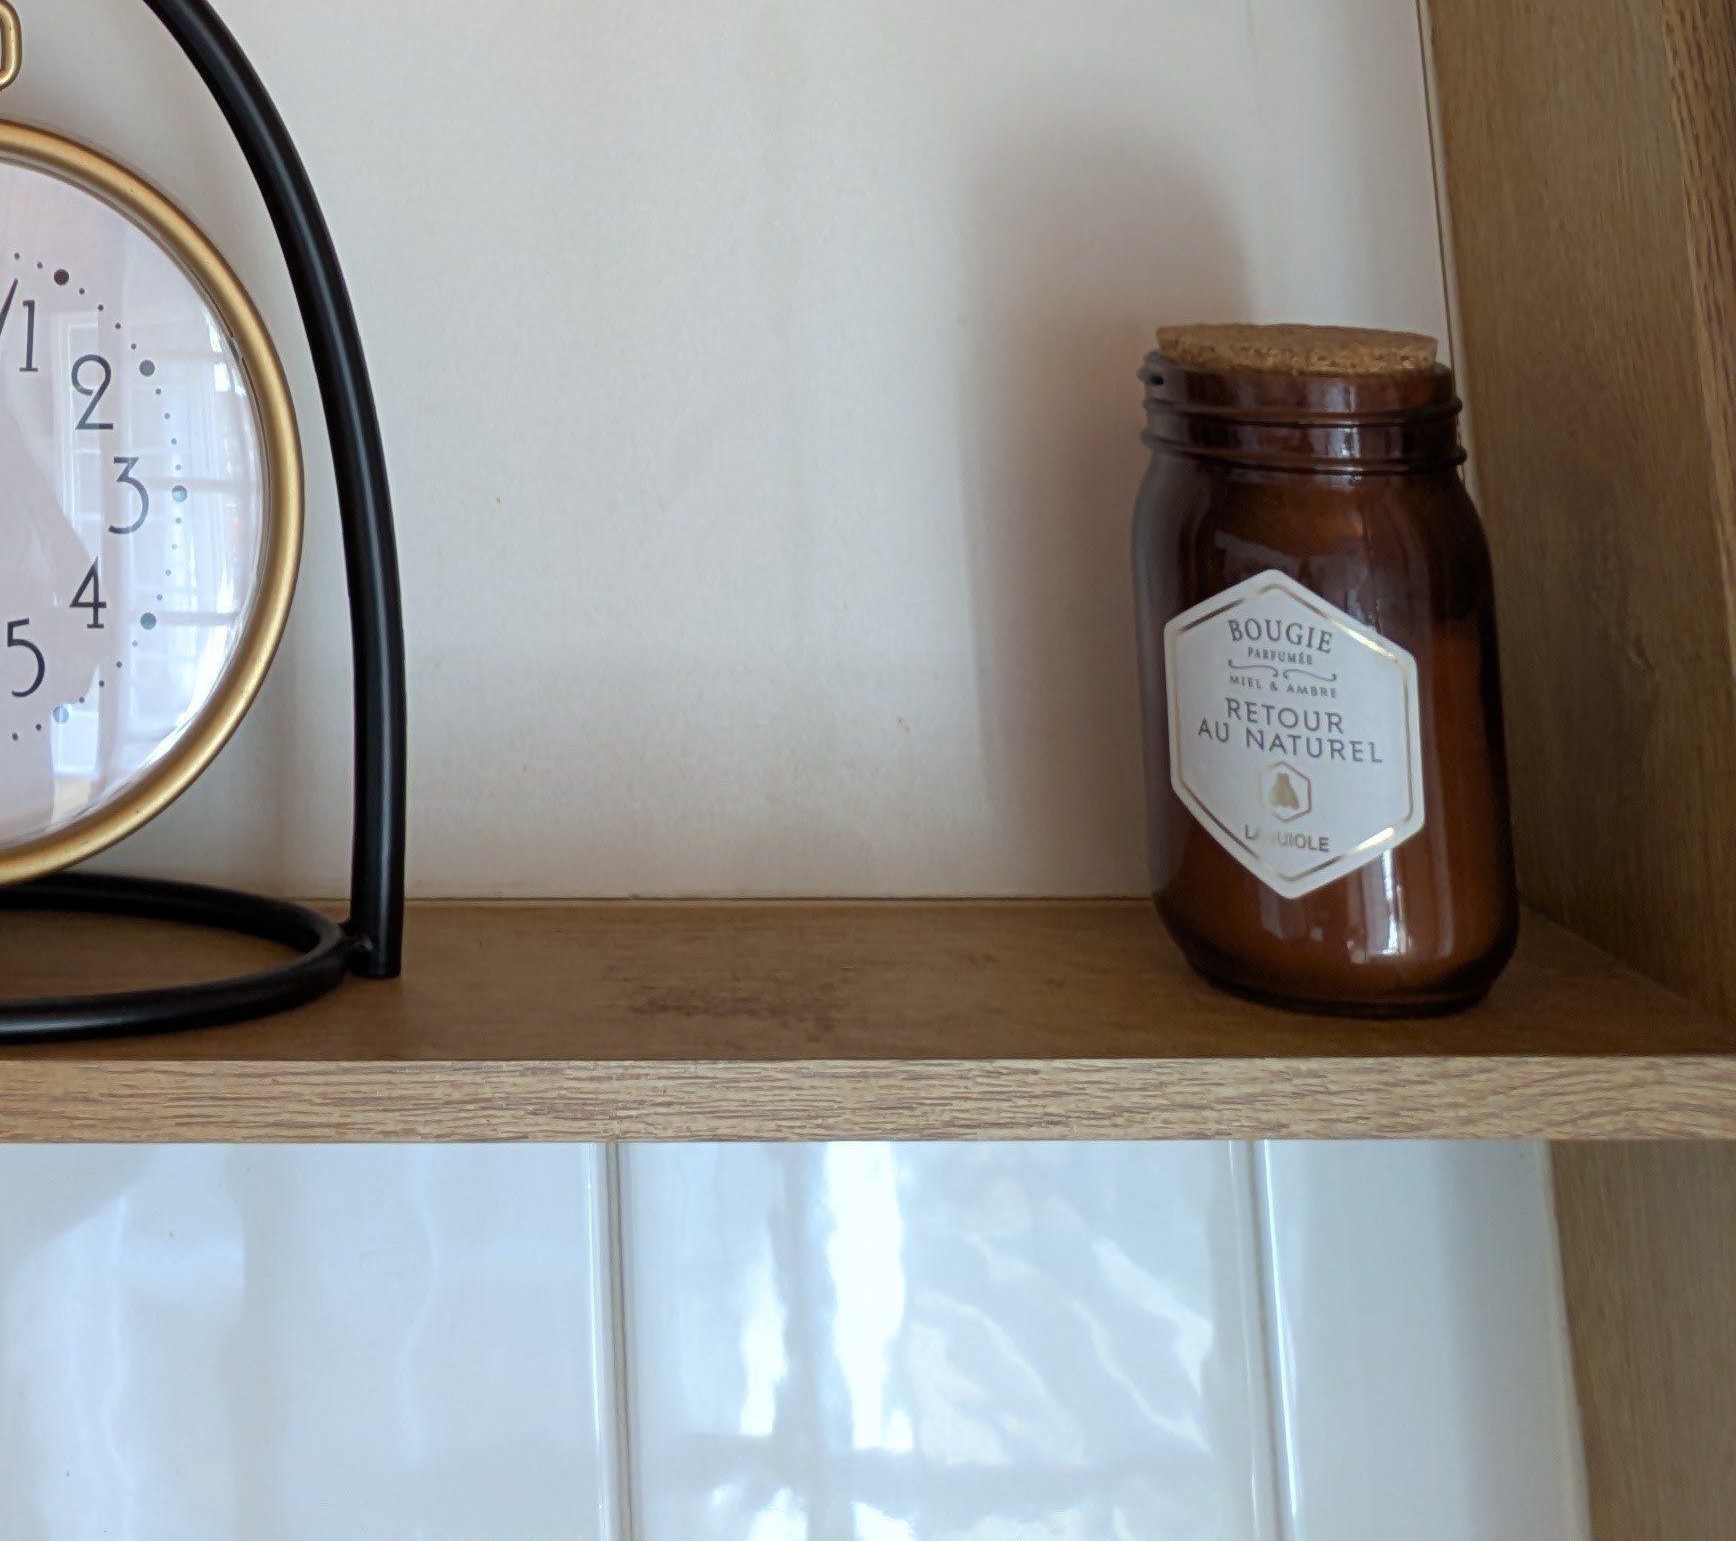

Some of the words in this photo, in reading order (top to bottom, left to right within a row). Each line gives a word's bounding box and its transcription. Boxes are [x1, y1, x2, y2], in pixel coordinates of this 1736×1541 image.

[19, 299, 39, 372] 1
[71, 355, 114, 430] 2
[107, 456, 149, 535] 3
[69, 556, 107, 629] 4
[6, 617, 45, 697] 5
[1228, 618, 1333, 654] BOUGIE
[1247, 646, 1313, 666] PARFUMÉE
[1225, 697, 1344, 734] RETOUR
[1229, 675, 1262, 690] MIEL
[1270, 681, 1278, 692] &
[1286, 685, 1337, 699] AMBRE
[1198, 718, 1230, 743] AU
[1245, 727, 1384, 764] NATUREL
